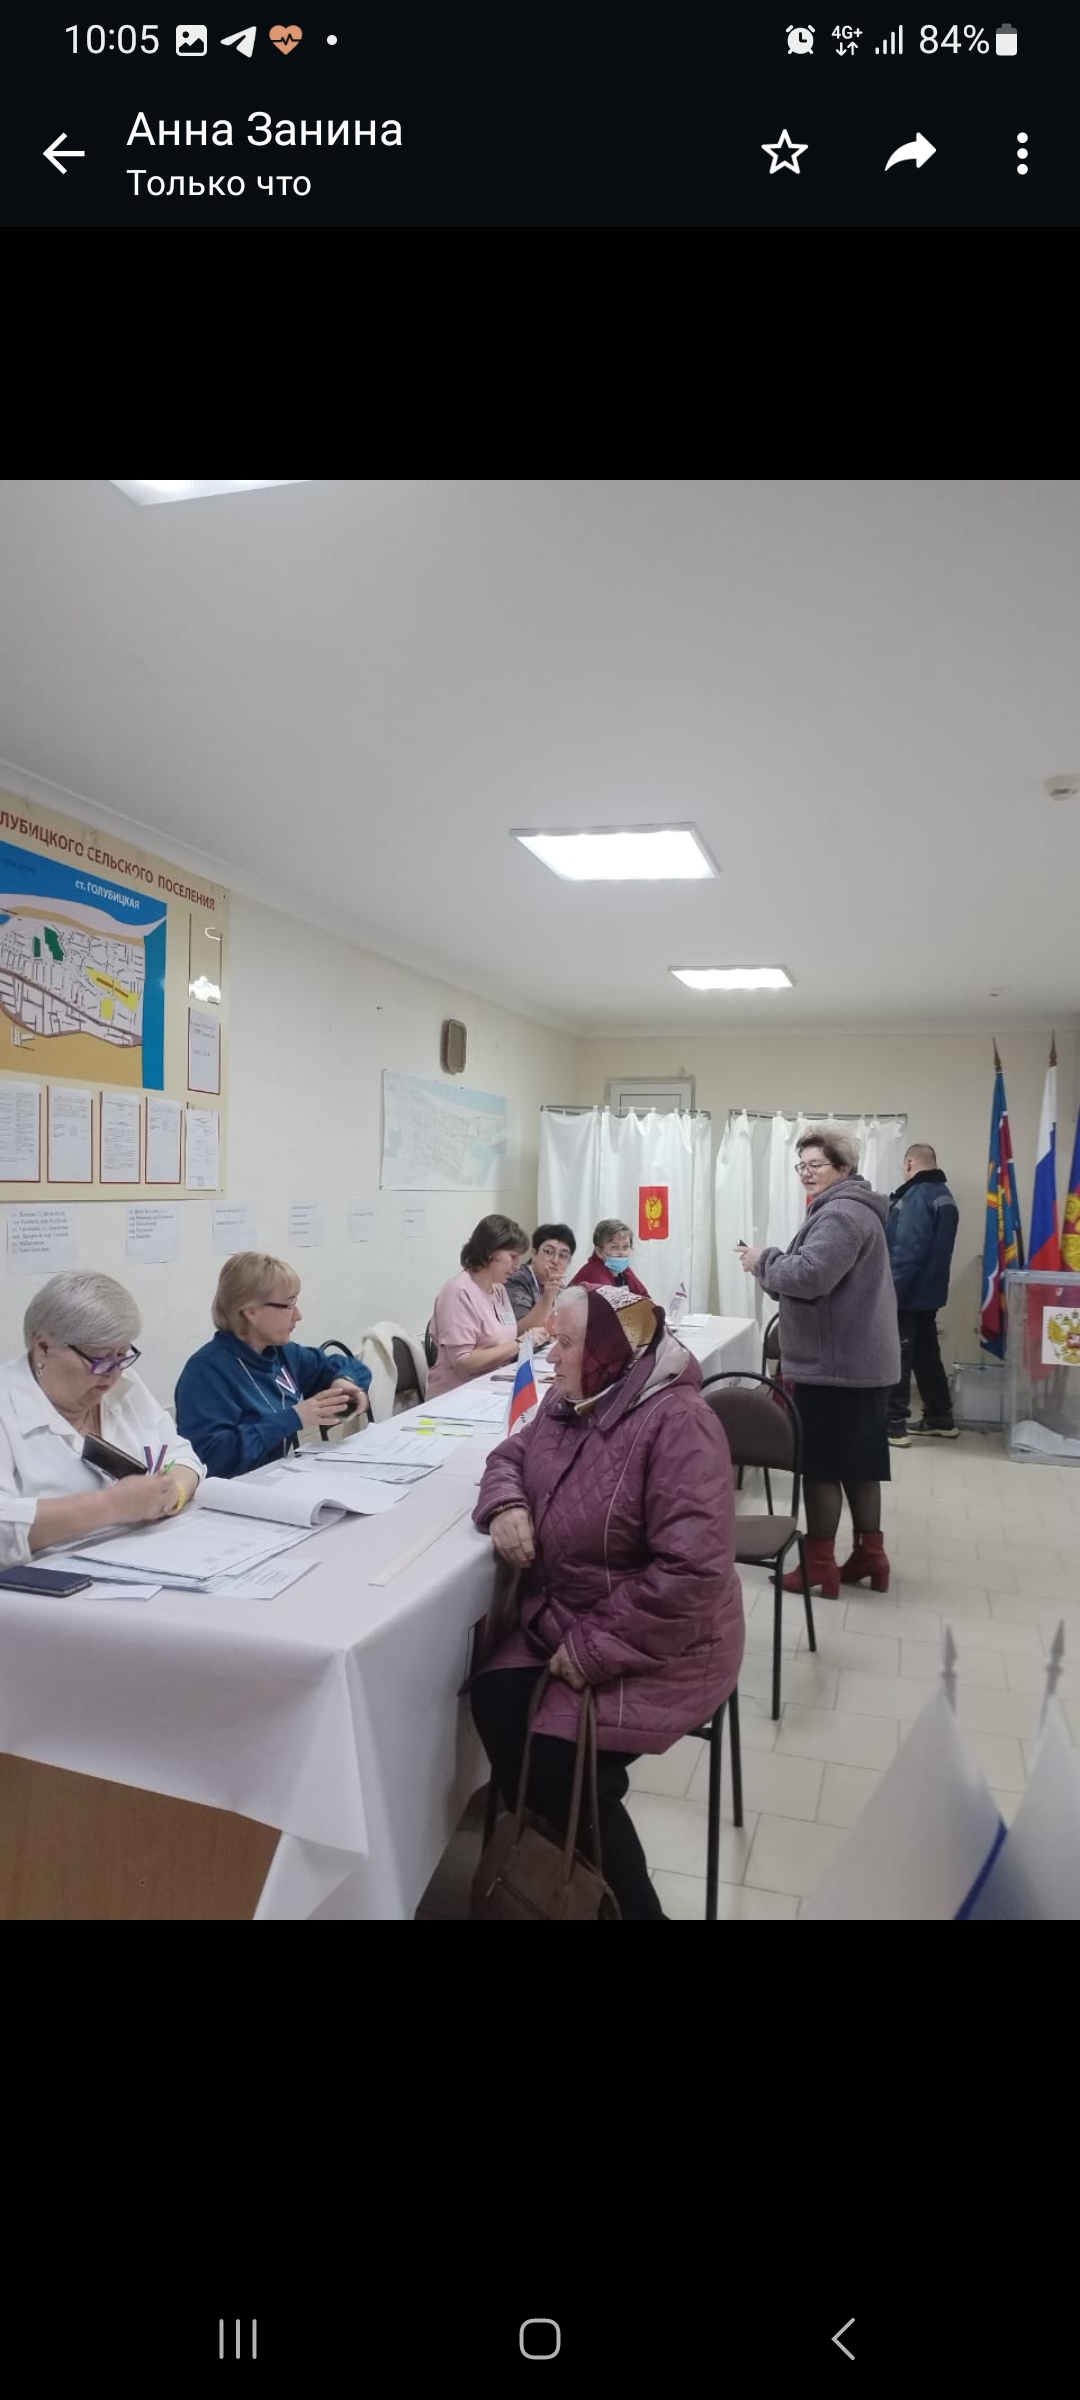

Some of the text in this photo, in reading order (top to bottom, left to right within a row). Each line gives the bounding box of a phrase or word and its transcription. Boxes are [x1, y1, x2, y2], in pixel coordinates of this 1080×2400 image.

[86, 846, 154, 884] СЕЛЬСКОГО
[157, 874, 216, 911] ПОСЕЛЕНИЯ
[86, 881, 141, 911] ГОЛУБИЦКАЯ
